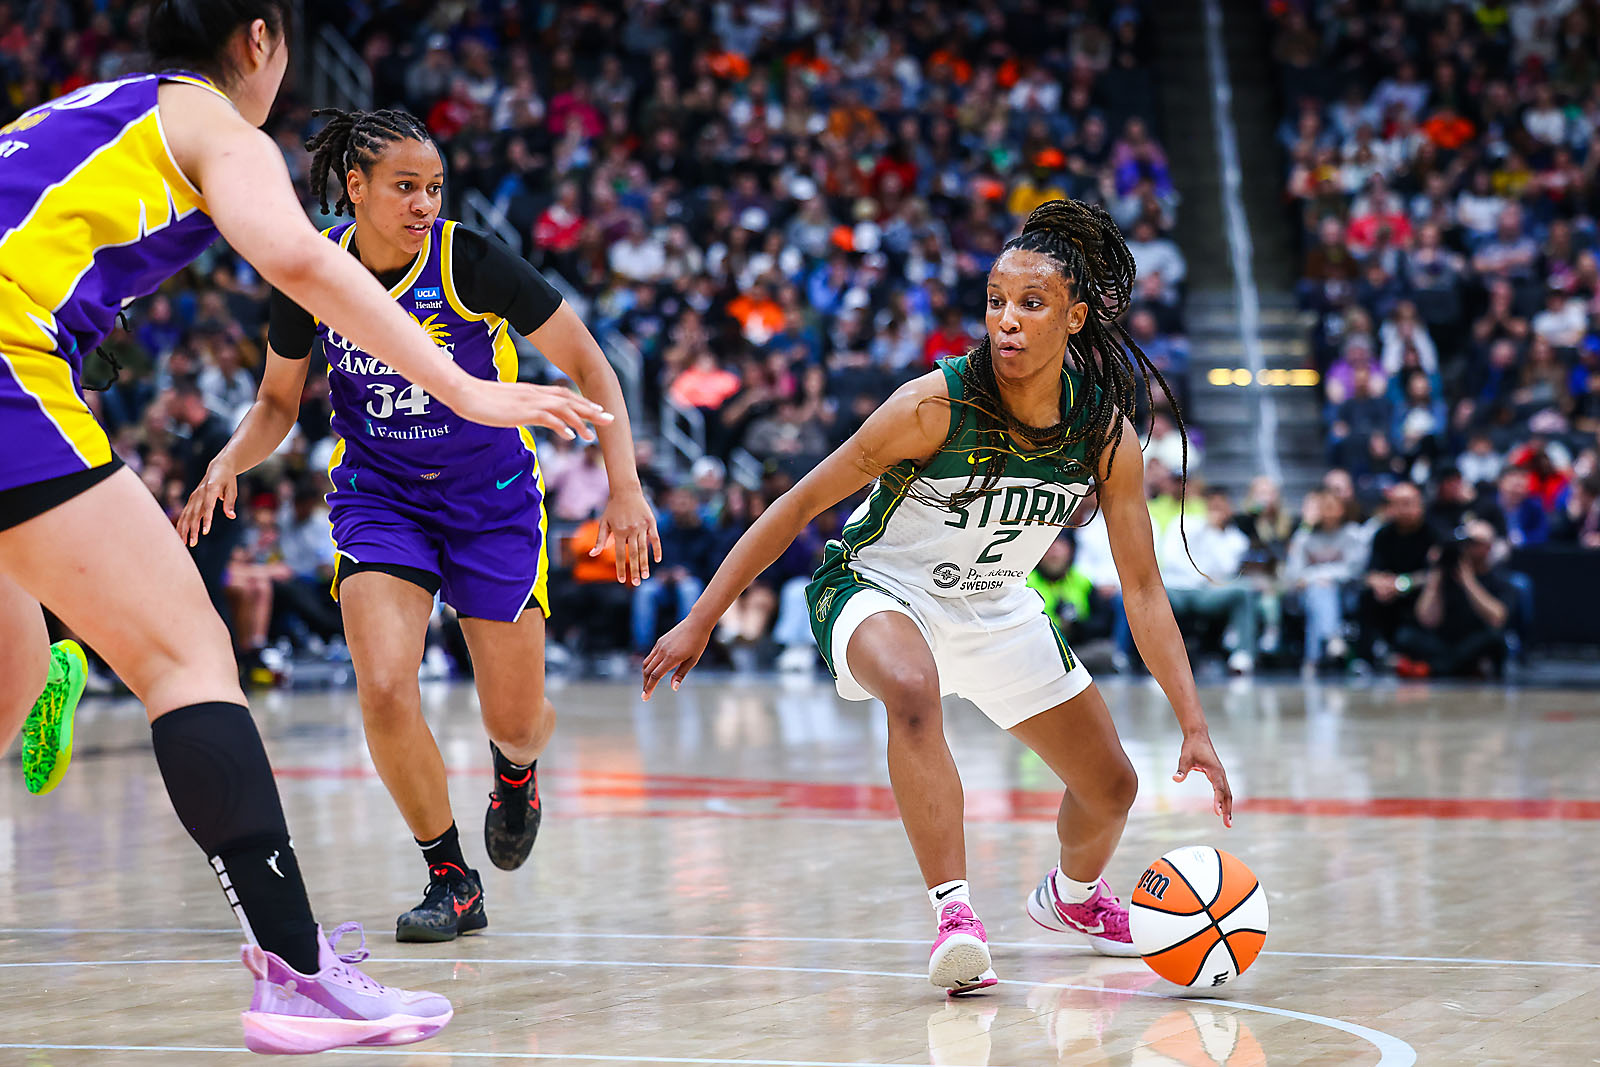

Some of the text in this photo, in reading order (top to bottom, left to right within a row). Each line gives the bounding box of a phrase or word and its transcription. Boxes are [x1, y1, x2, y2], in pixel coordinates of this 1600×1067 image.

[417, 290, 437, 298] UCLA
[327, 326, 367, 352] LO
[366, 383, 431, 418] 34
[944, 486, 1079, 529] STORM
[975, 529, 1023, 564] 2
[960, 580, 1004, 591] SWEDISH
